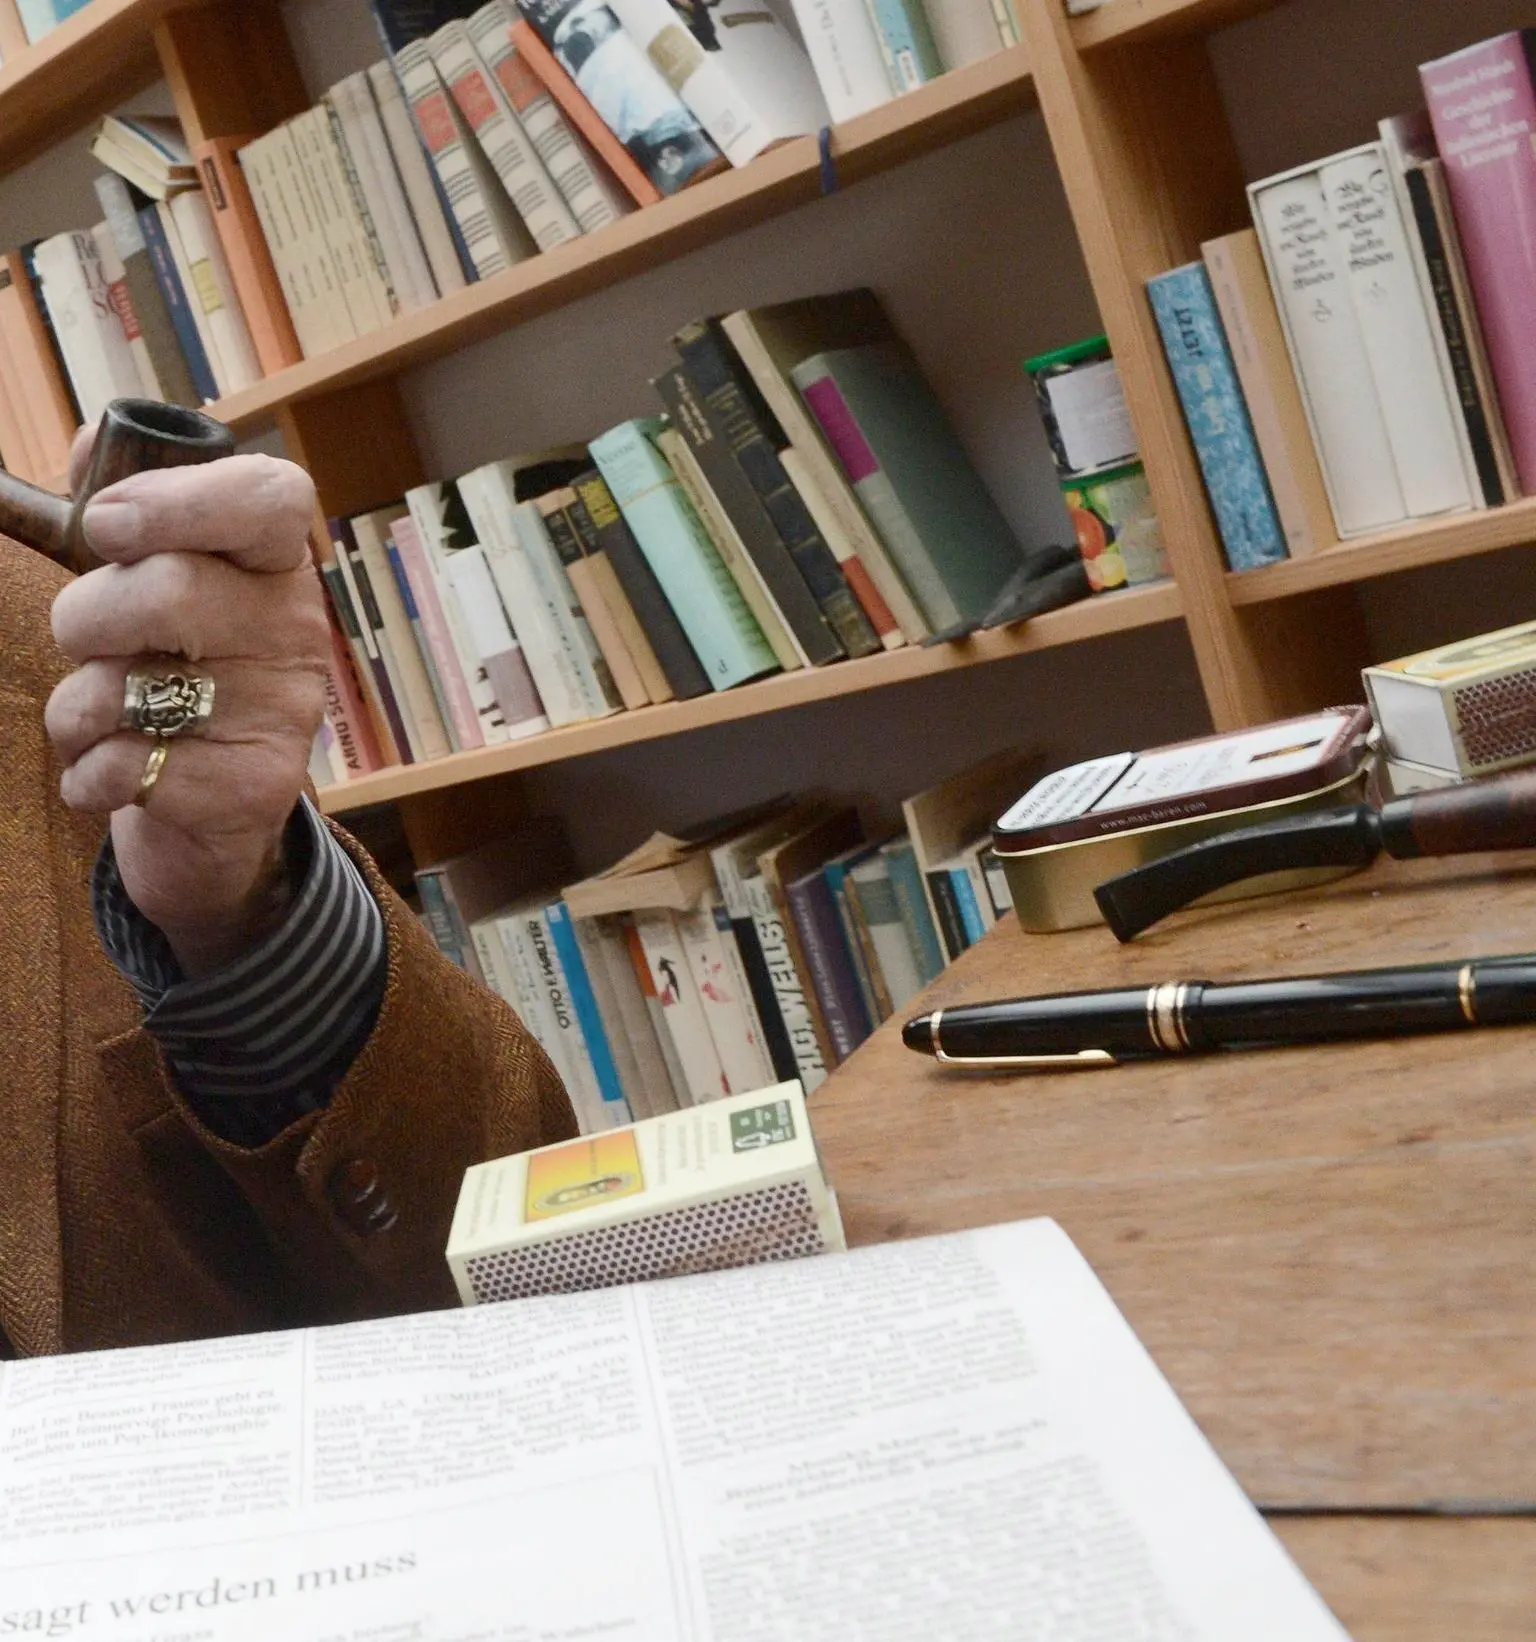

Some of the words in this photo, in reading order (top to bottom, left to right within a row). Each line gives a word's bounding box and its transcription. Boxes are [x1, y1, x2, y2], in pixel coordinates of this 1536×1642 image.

[334, 721, 362, 770] ARNO
[548, 988, 571, 1030] OTTO
[109, 1577, 277, 1619] werden
[294, 1550, 418, 1595] muss
